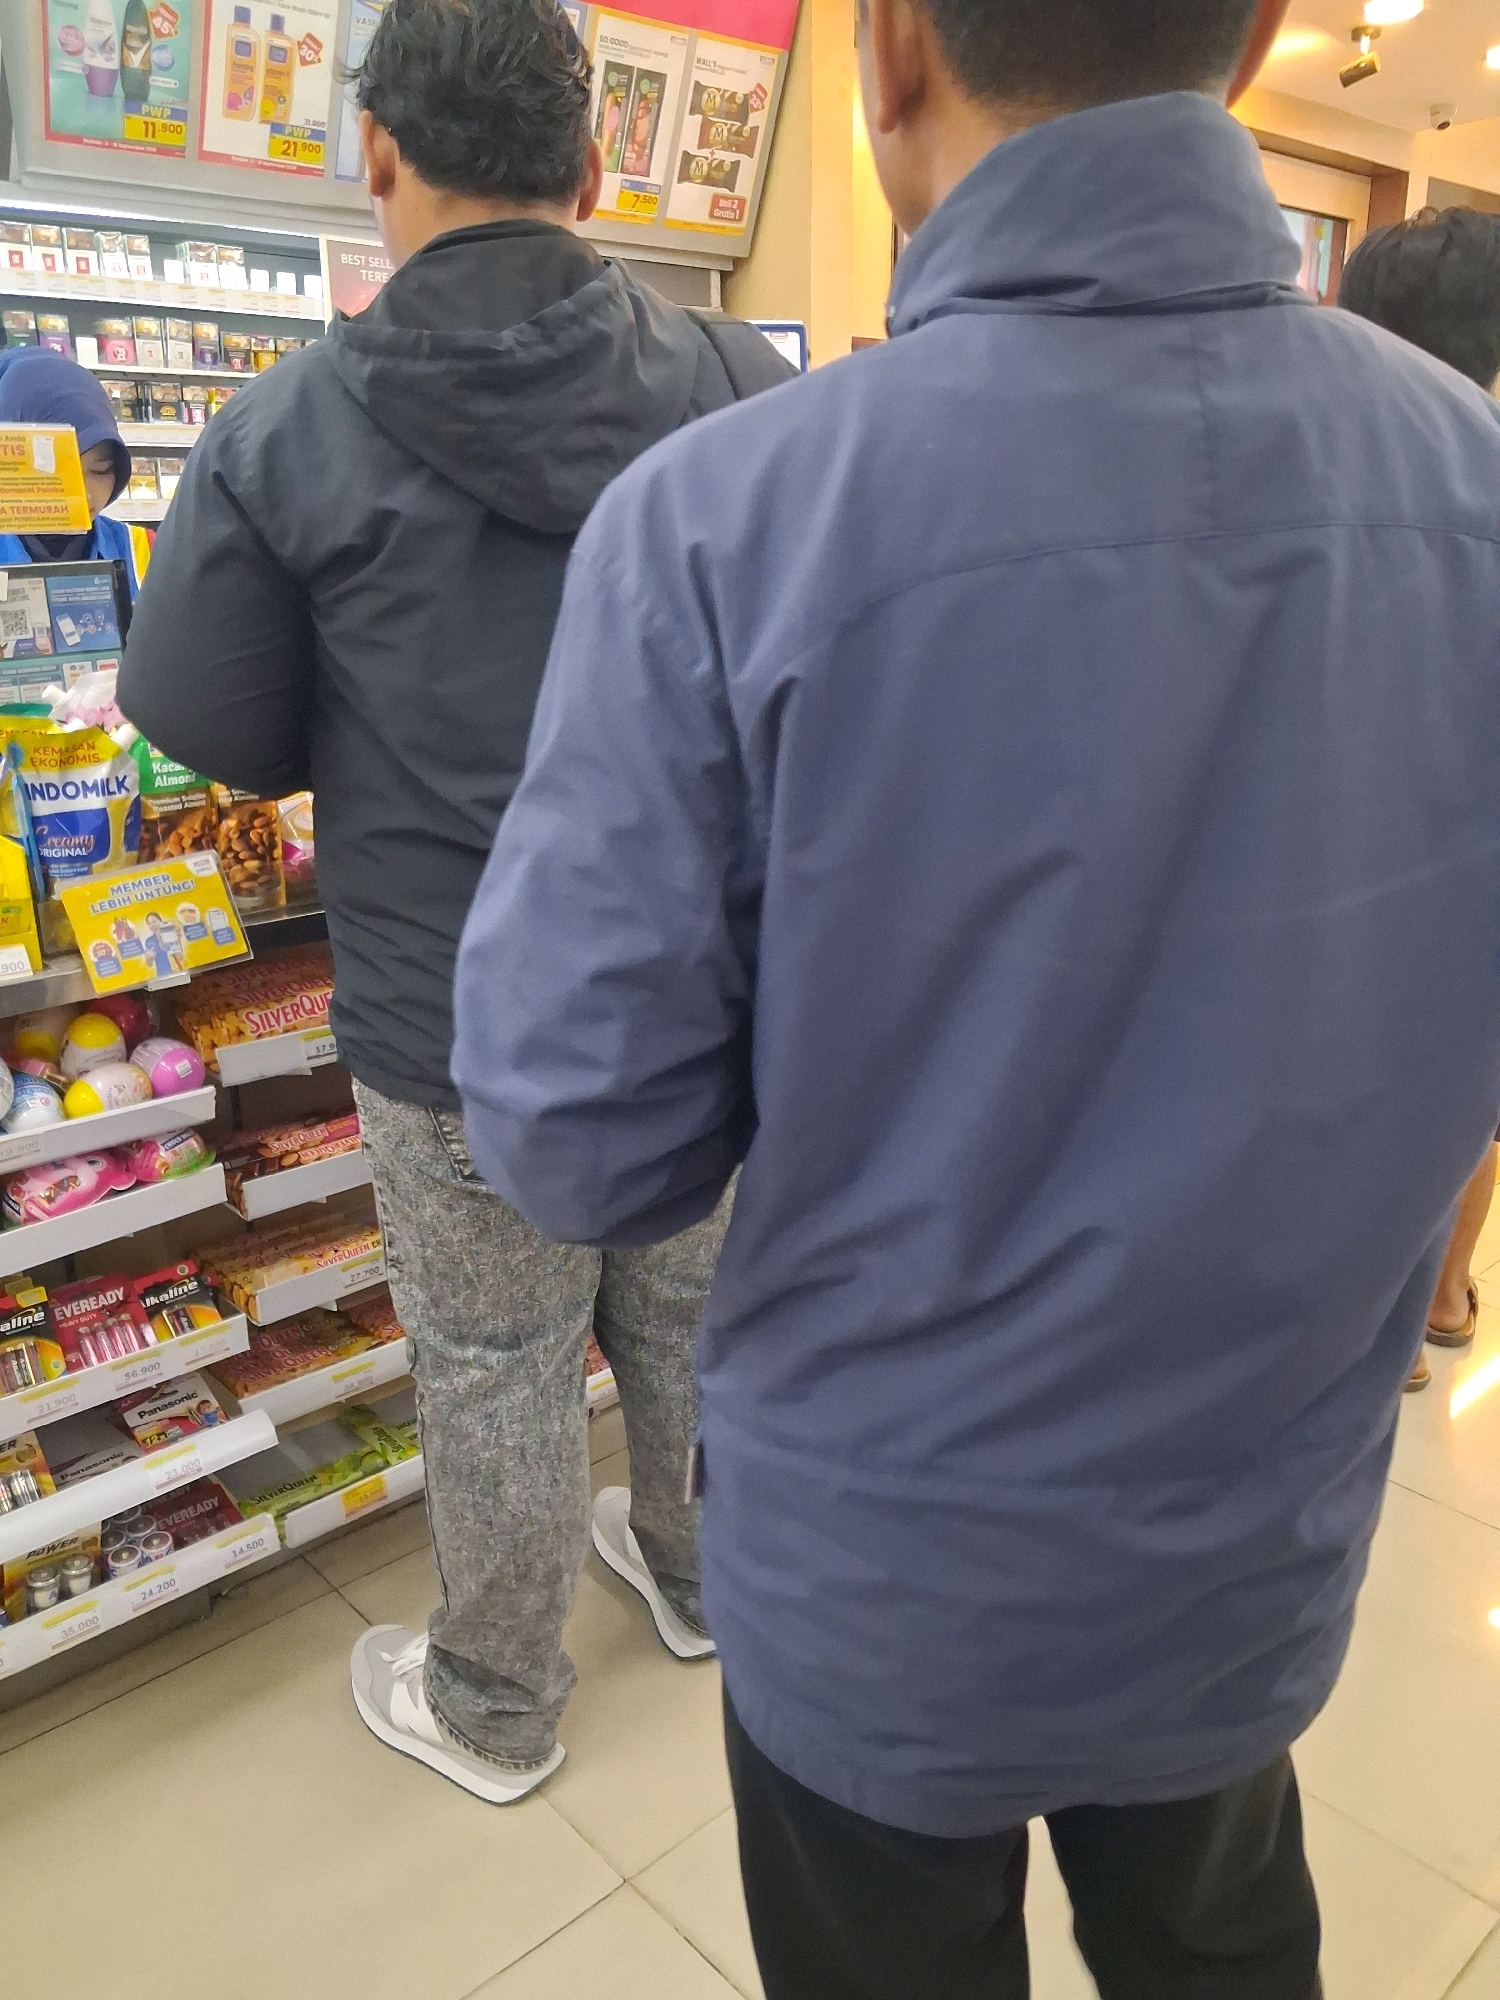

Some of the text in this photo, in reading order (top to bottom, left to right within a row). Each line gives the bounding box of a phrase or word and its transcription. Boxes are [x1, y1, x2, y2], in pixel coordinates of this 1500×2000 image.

[142, 105, 171, 119] PWP
[285, 125, 312, 139] PWP
[281, 140, 321, 157] 21.900
[632, 193, 657, 208] 7.500
[341, 253, 366, 266] BEST
[9, 504, 69, 515] TERMURAH
[33, 742, 96, 756] KEMASAN
[31, 753, 100, 769] EKONOMIS
[24, 775, 130, 802] INDOMILK
[155, 773, 196, 788] Almond
[110, 874, 171, 896] MEMBER
[90, 880, 195, 914] LEBIH UNTUNG!
[270, 1127, 329, 1153] SILVERQUEEN
[316, 1243, 370, 1268] SILVERQUEEN
[54, 1287, 125, 1321] EVEREADY
[80, 1313, 97, 1323] DUTY
[124, 1361, 161, 1380] 56.900
[137, 1390, 199, 1420] Panasonic
[59, 1451, 125, 1481] Panasonic
[252, 1474, 318, 1505] SILVERQUEEN
[156, 1496, 220, 1531] EVEREADY
[26, 1536, 79, 1560] POWER
[232, 1537, 265, 1558] 14.500
[140, 1578, 177, 1602] 24.200
[60, 1615, 100, 1640] 35.000
